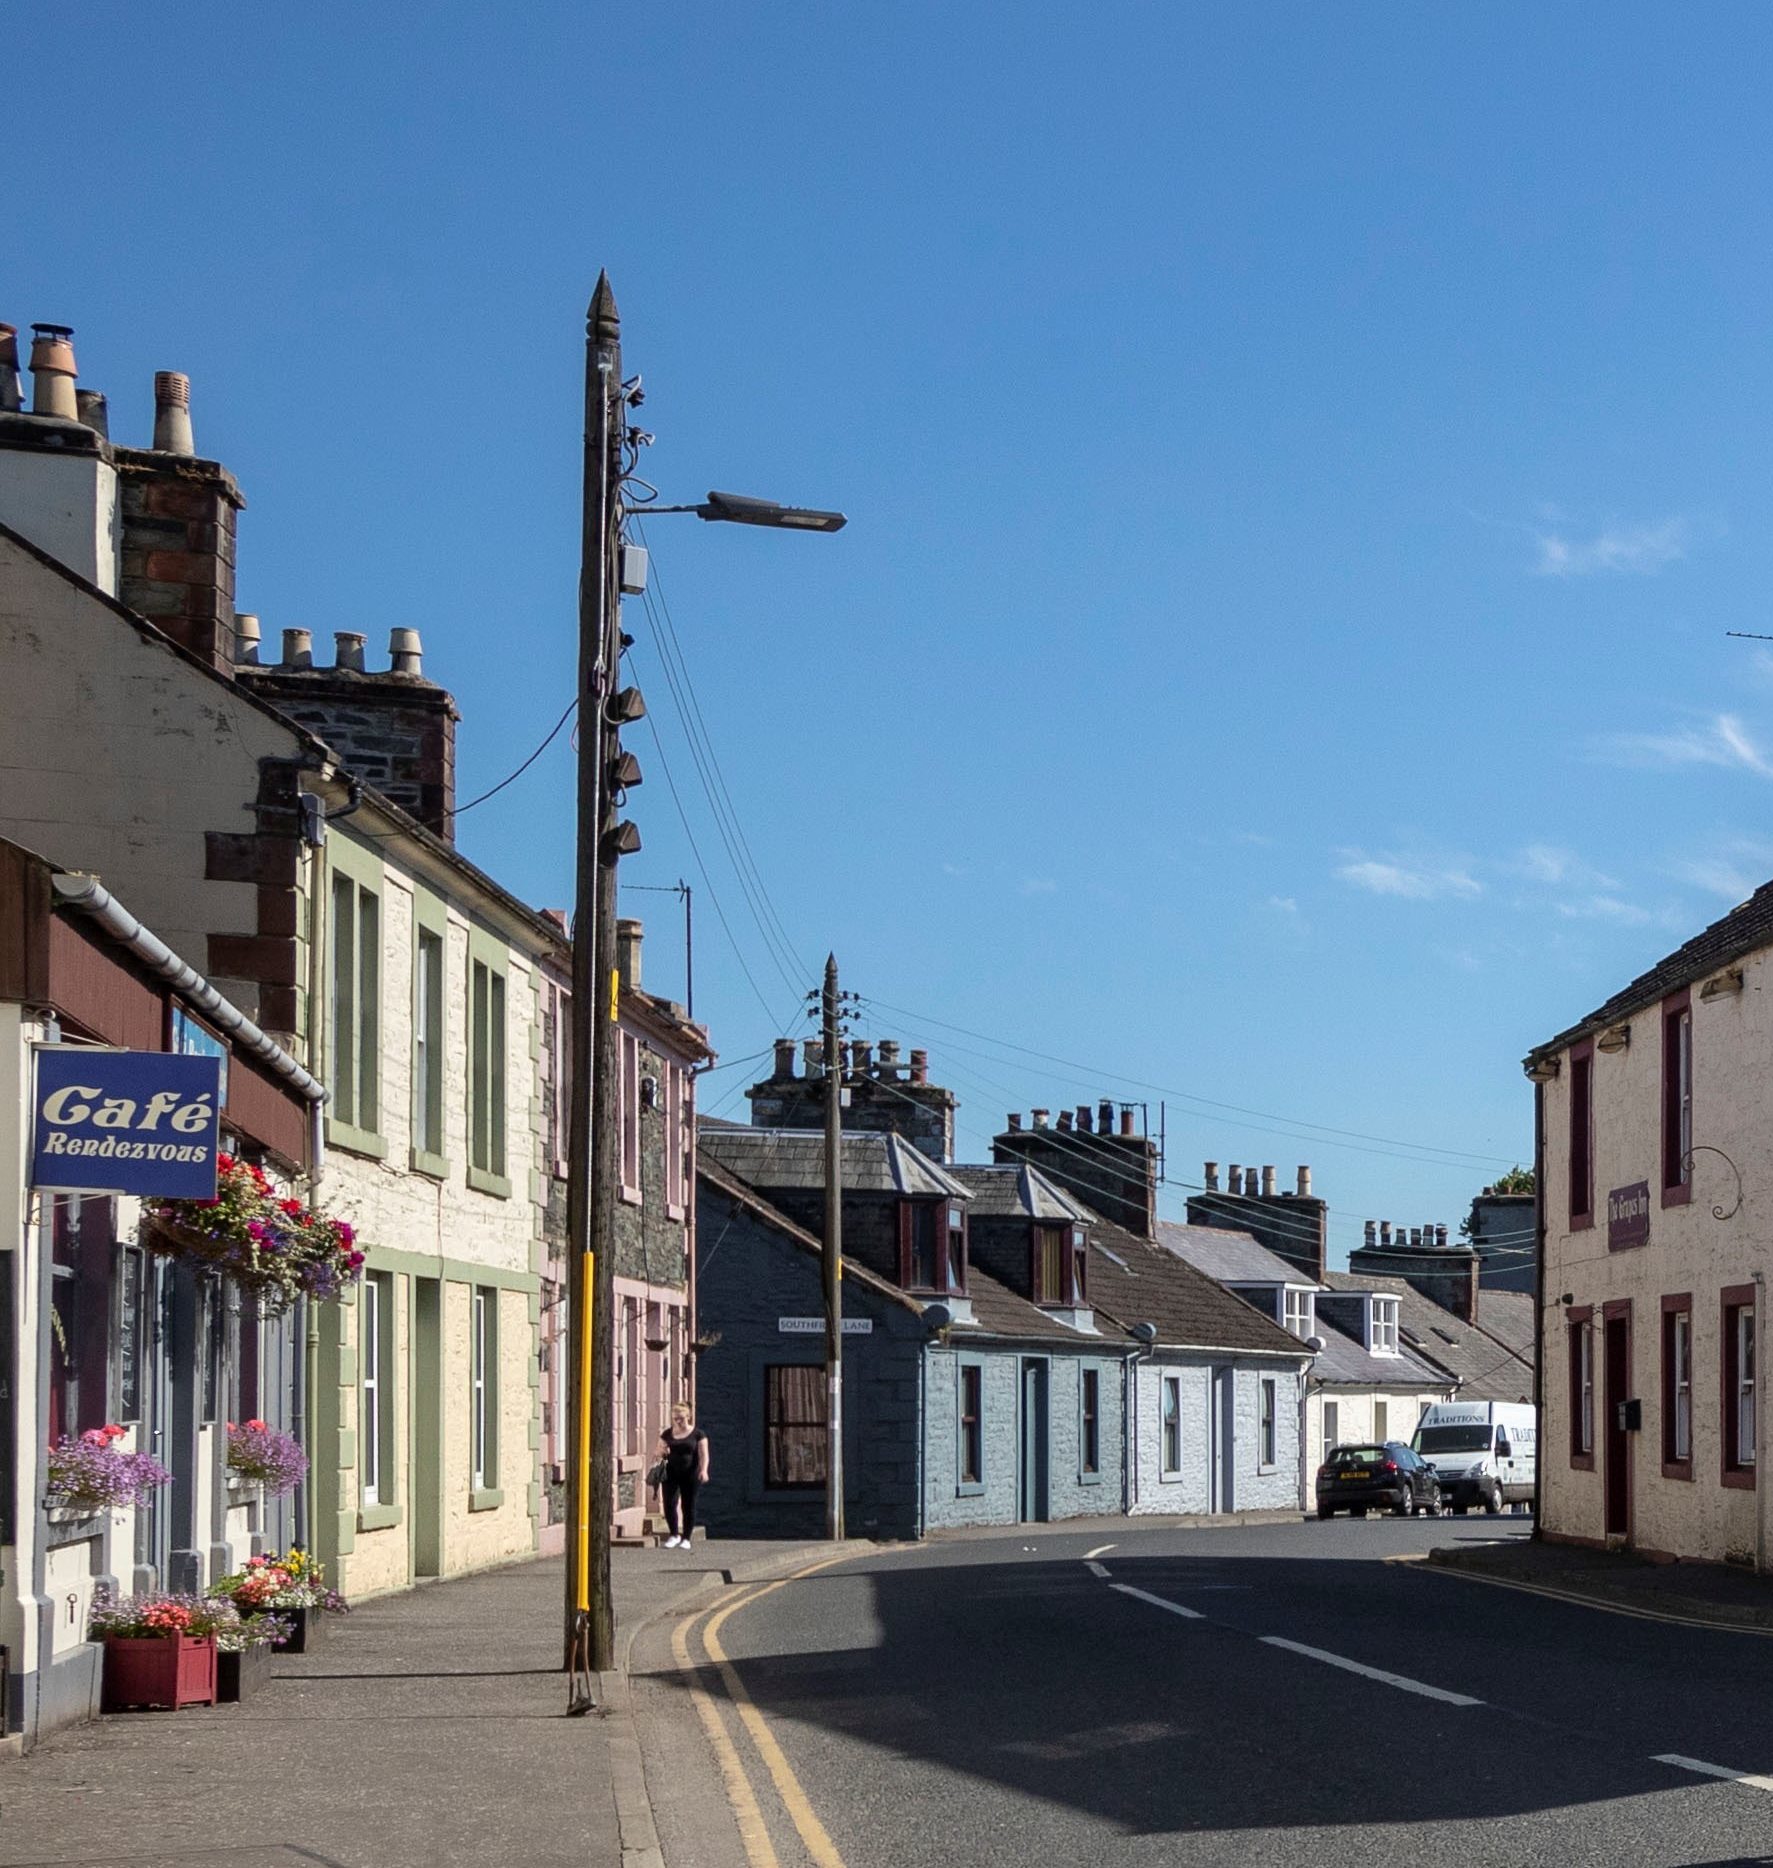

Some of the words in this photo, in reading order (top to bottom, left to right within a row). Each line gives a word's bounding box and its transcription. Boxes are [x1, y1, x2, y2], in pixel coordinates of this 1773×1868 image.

[42, 1085, 213, 1133] Café
[43, 1131, 209, 1163] Rendezvous
[1609, 1197, 1618, 1223] The
[844, 1321, 870, 1330] LANE
[1428, 1415, 1485, 1425] TRADITIONS
